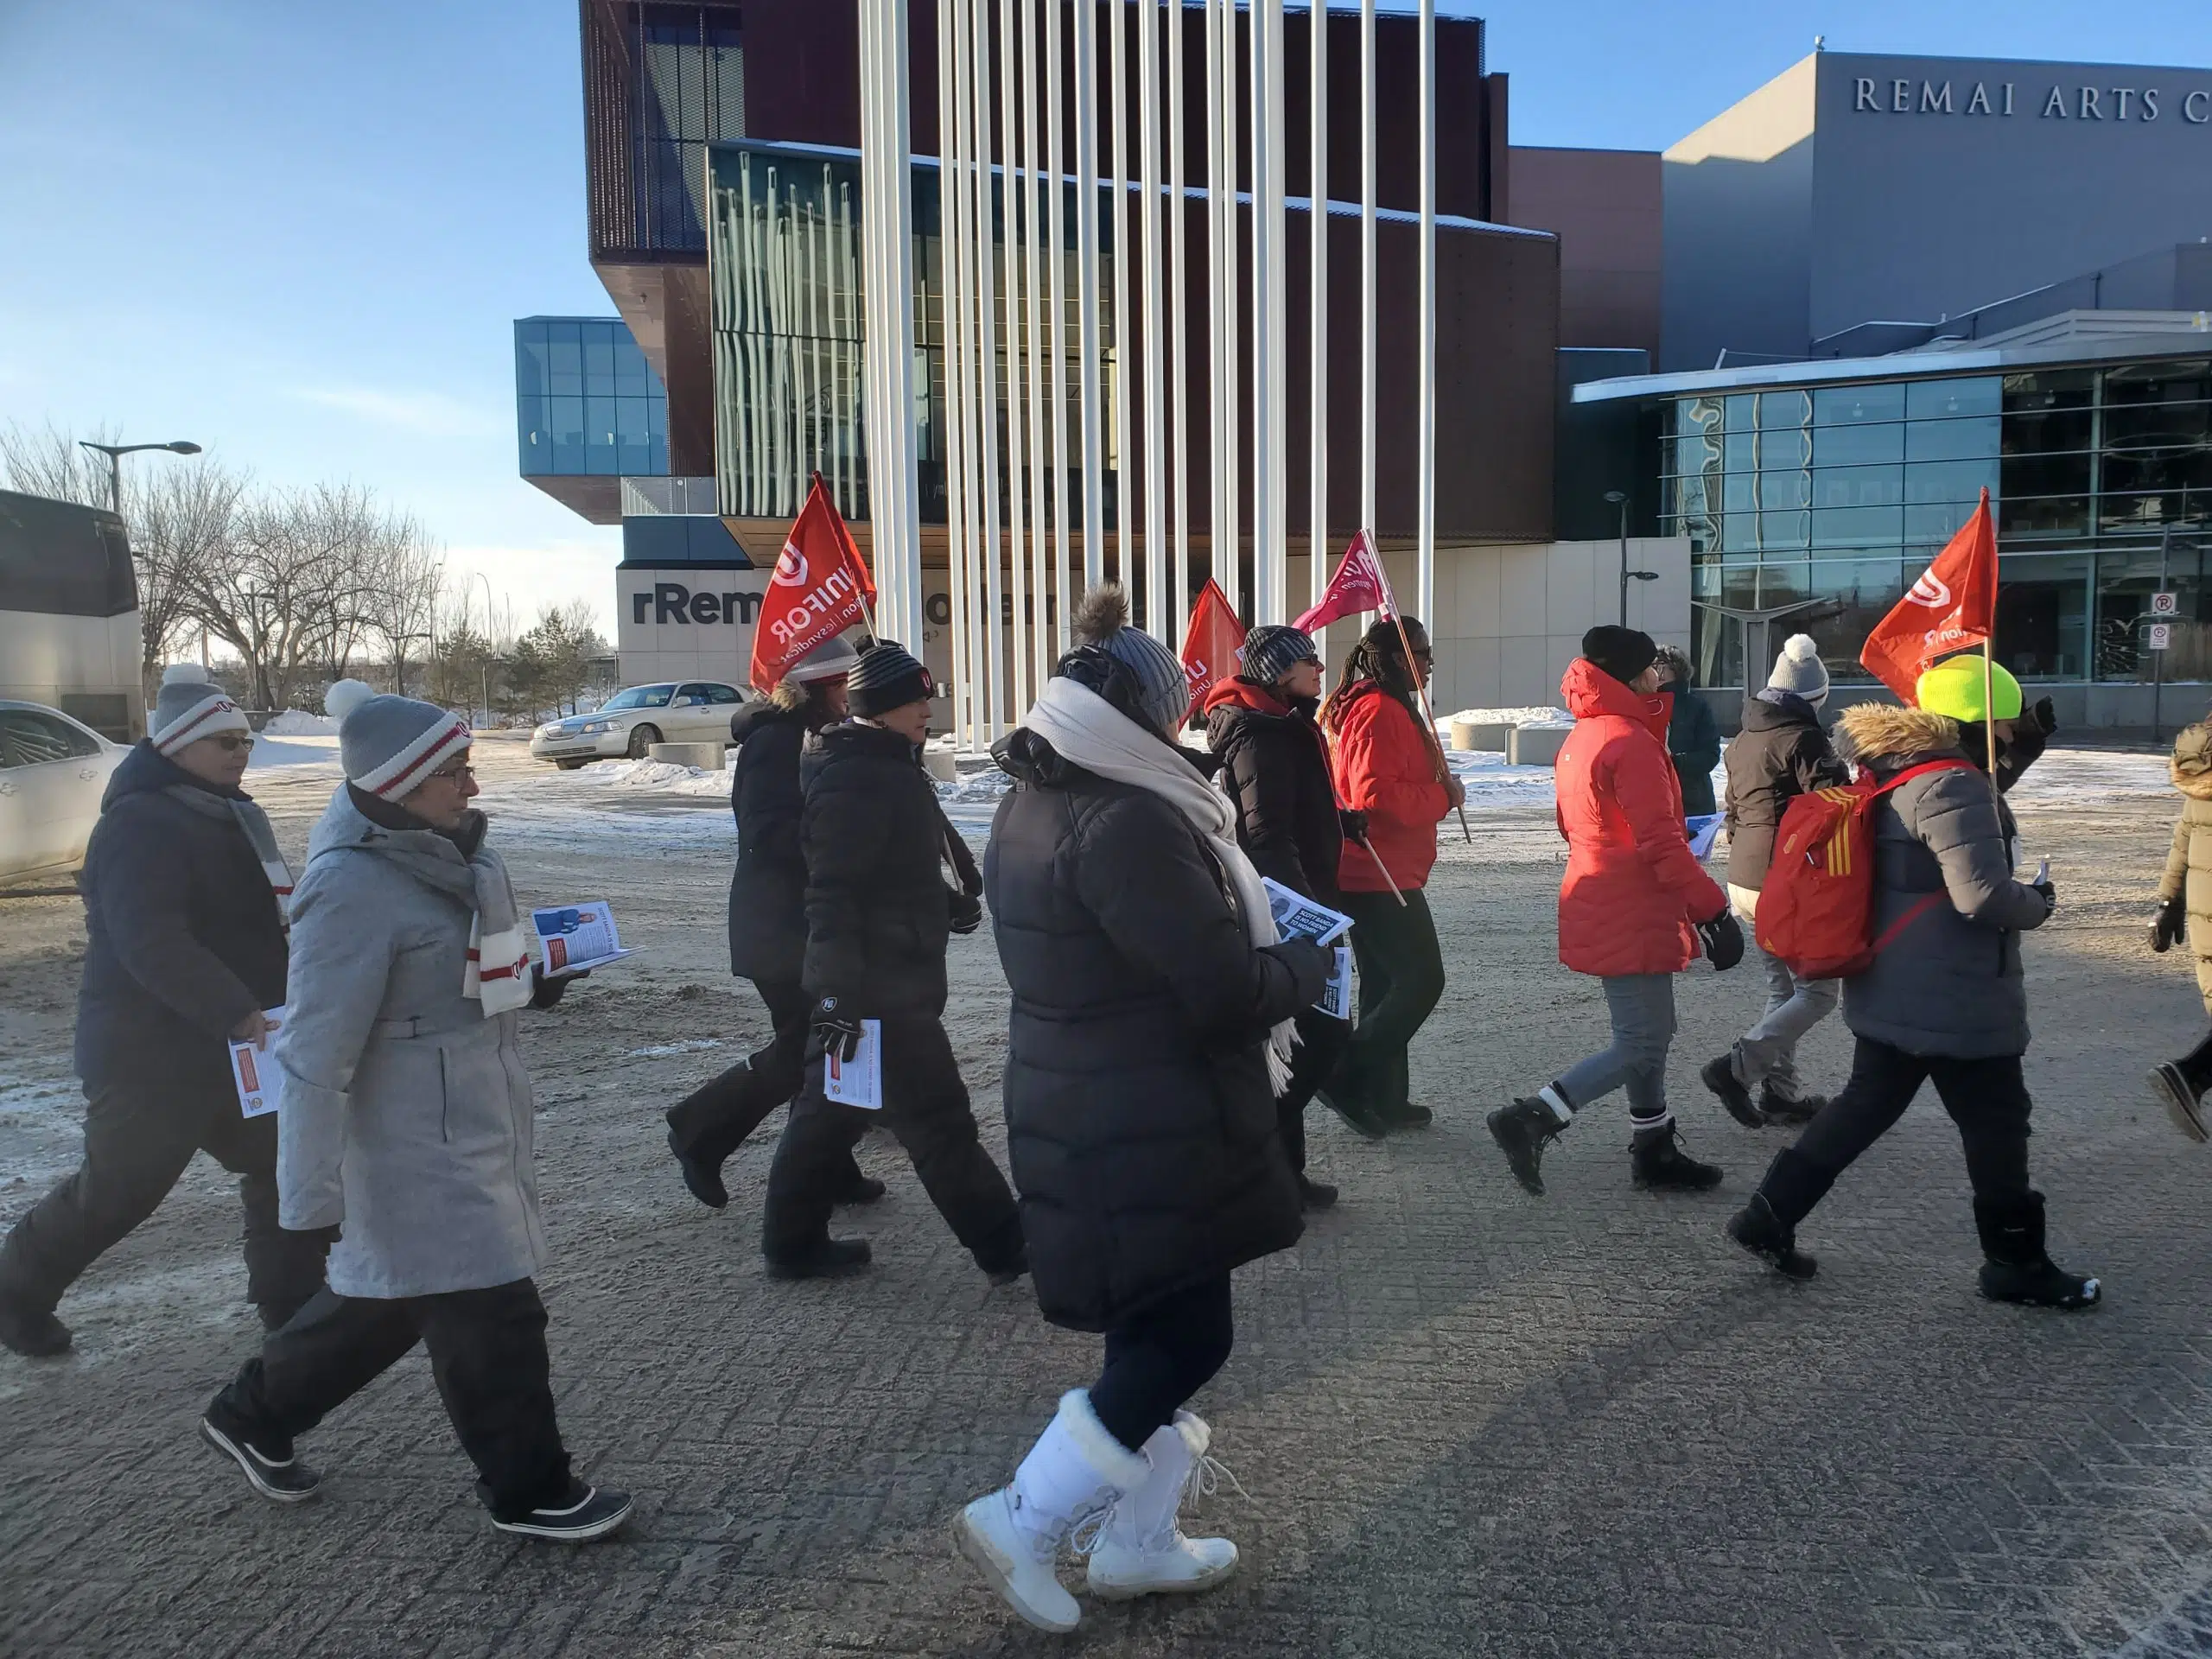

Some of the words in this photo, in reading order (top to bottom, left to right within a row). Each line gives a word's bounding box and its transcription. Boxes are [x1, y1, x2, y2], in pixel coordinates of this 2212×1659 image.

[1856, 78, 2014, 116] REMAI
[2043, 86, 2159, 121] ARTS
[633, 583, 764, 625] rRem
[1300, 910, 1318, 920] SCOTT
[1298, 923, 1318, 933] WOMEN
[1308, 920, 1327, 931] FRIEND
